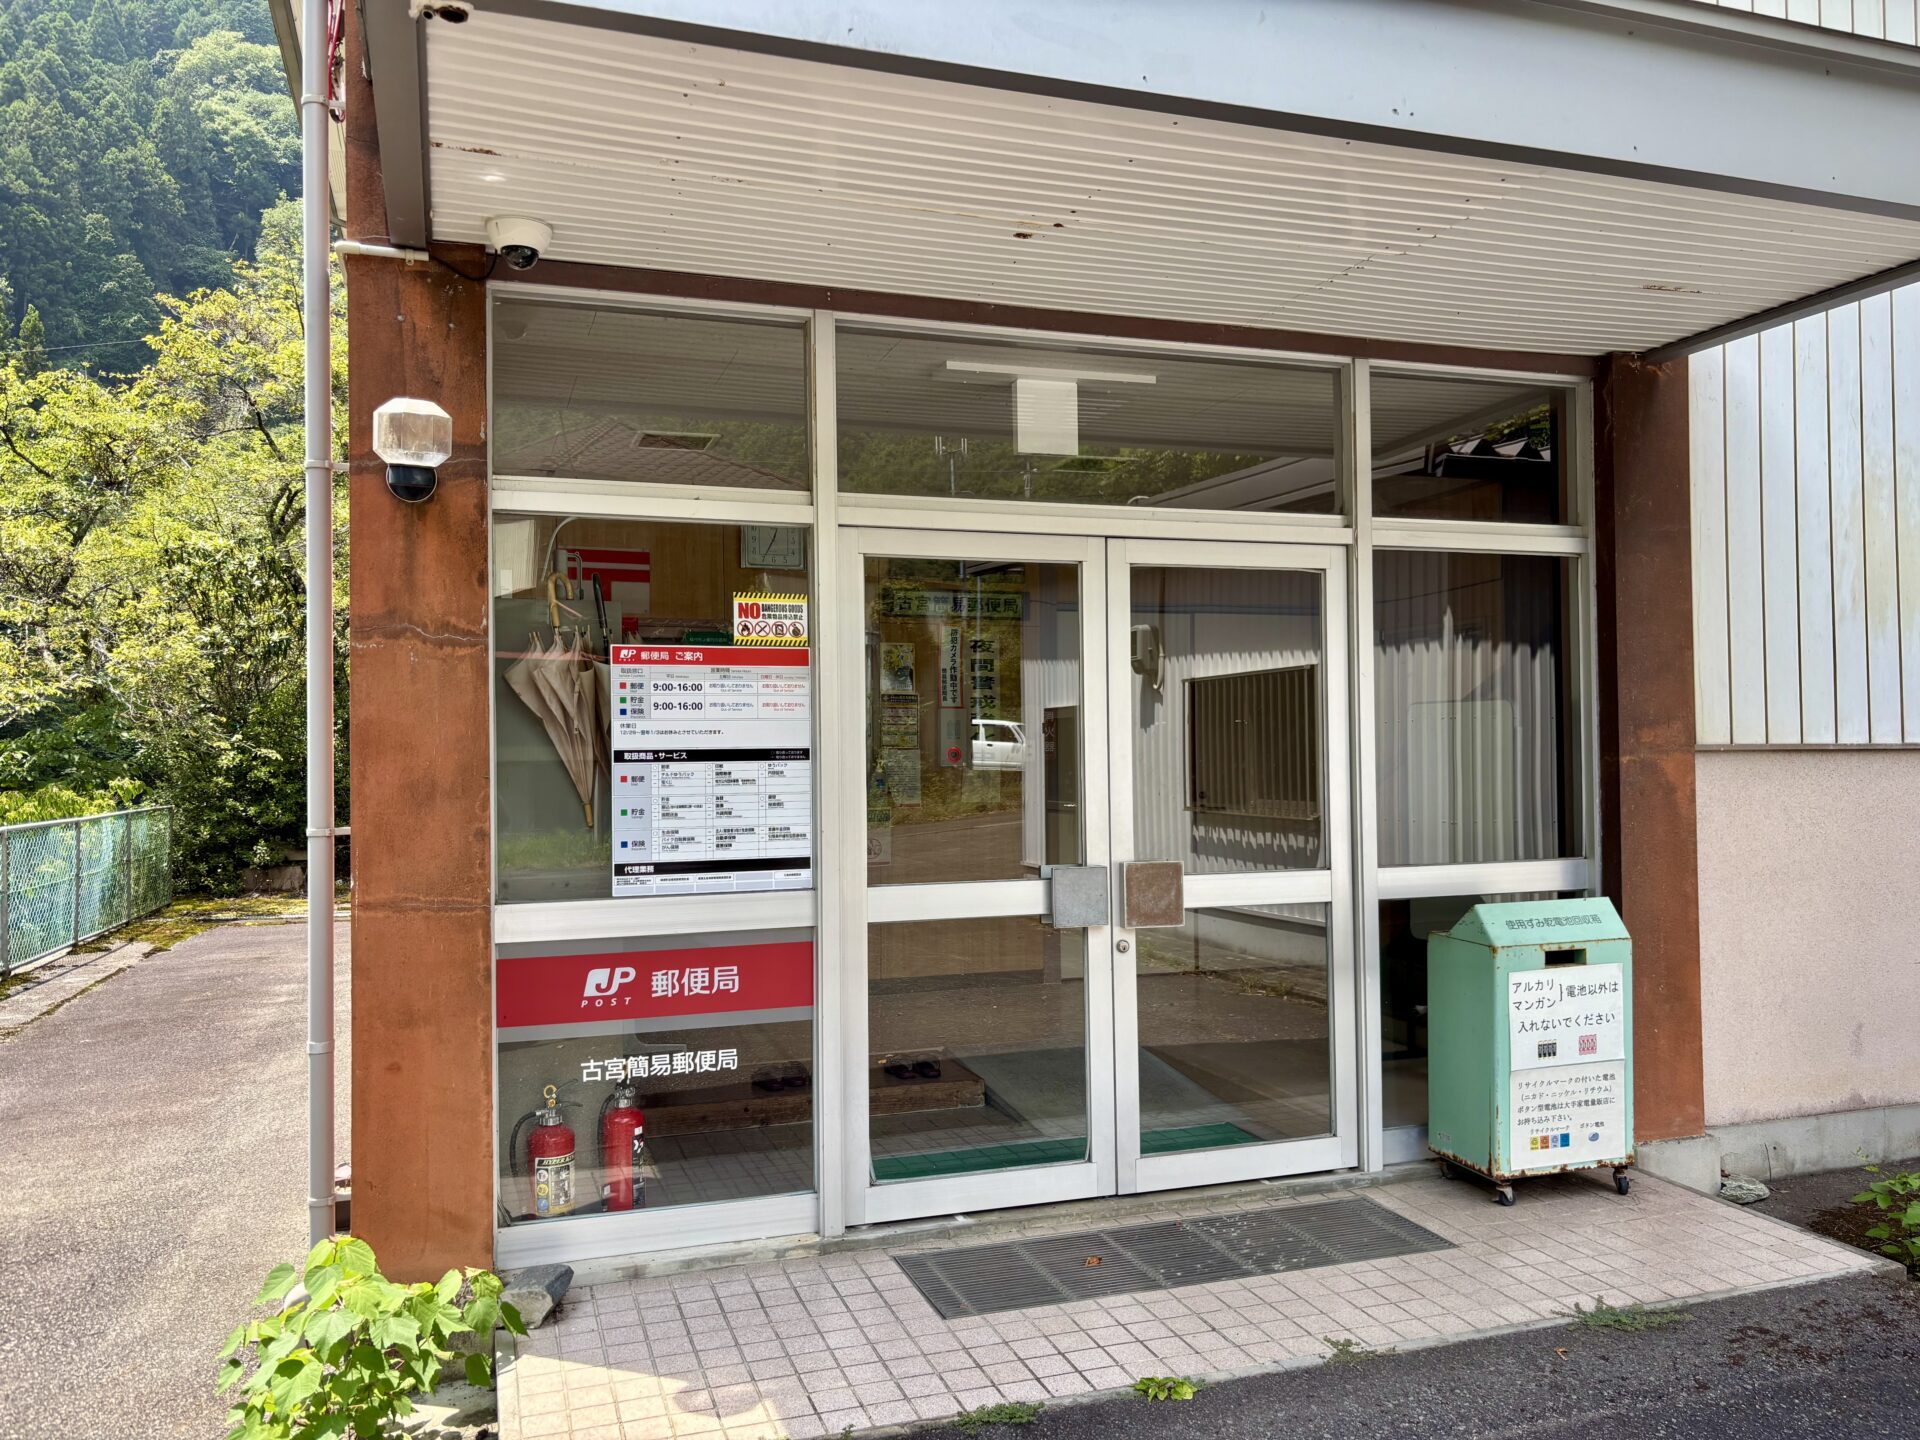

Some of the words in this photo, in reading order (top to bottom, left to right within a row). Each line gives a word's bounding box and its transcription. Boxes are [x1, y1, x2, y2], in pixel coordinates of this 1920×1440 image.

[738, 602, 760, 619] NO
[762, 603, 787, 613] DANGEROUS
[788, 604, 803, 613] GOODS
[640, 651, 670, 661] 郵便局
[675, 651, 704, 661] ご案内
[652, 683, 703, 692] 9:00-16:00
[653, 702, 703, 711] 9:00-16:00
[624, 752, 688, 760] 取扱商品・サービス
[631, 808, 645, 816] 貯金
[631, 840, 646, 848] 保険
[583, 966, 637, 997] JP
[651, 965, 739, 998] 郵便局
[1512, 979, 1554, 994] アルカリ
[1566, 981, 1619, 998] 電池以外は
[581, 997, 631, 1008] POST
[1512, 997, 1556, 1011] マンガン
[1518, 1012, 1616, 1034] 入れないでください
[581, 1048, 739, 1083] 古宮簡易郵便局
[1518, 1073, 1616, 1089] リサイクルマークの付いた電池
[1517, 1097, 1616, 1114] ボタン型電池は大手家電量販店に
[1517, 1114, 1573, 1126] お持ち込み下さい。
